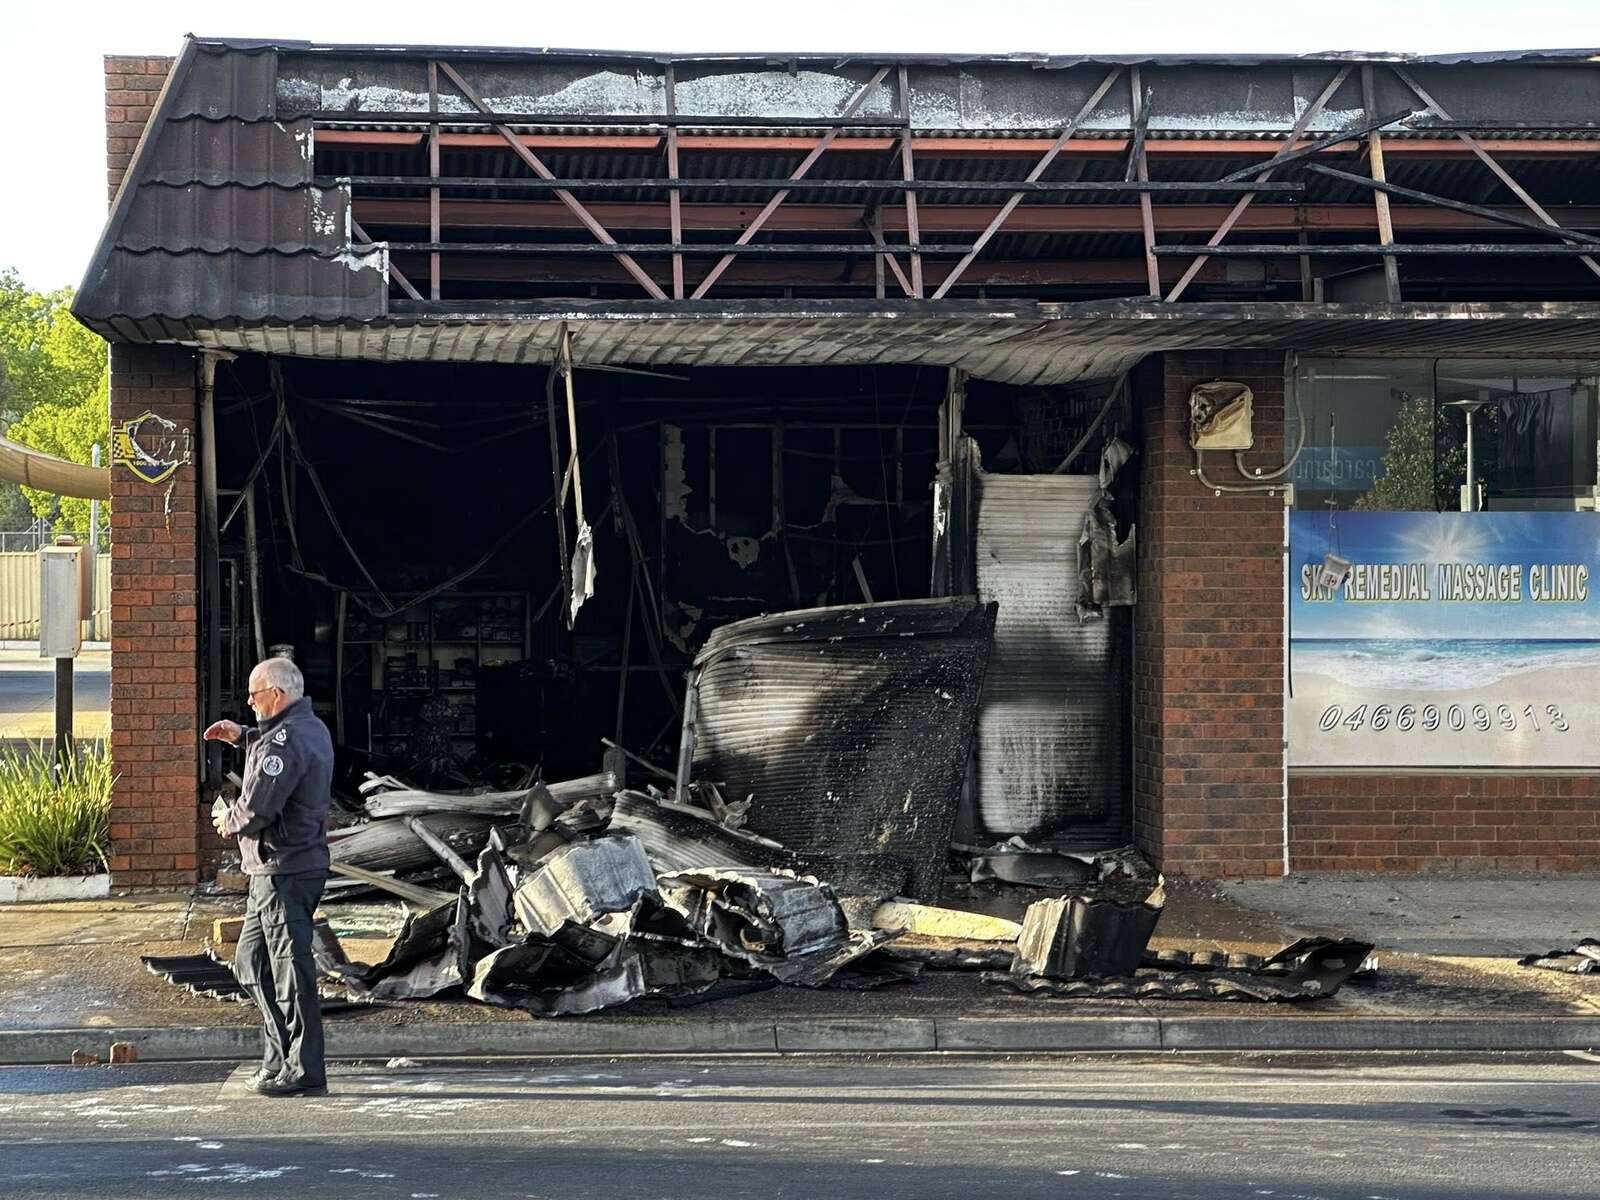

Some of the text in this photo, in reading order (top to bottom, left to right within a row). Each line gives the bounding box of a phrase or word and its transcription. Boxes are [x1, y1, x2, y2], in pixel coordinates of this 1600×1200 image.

[1301, 563, 1588, 602] SK REMEDIAL MASSAGE CLINIC
[1318, 703, 1570, 733] 0466909913
